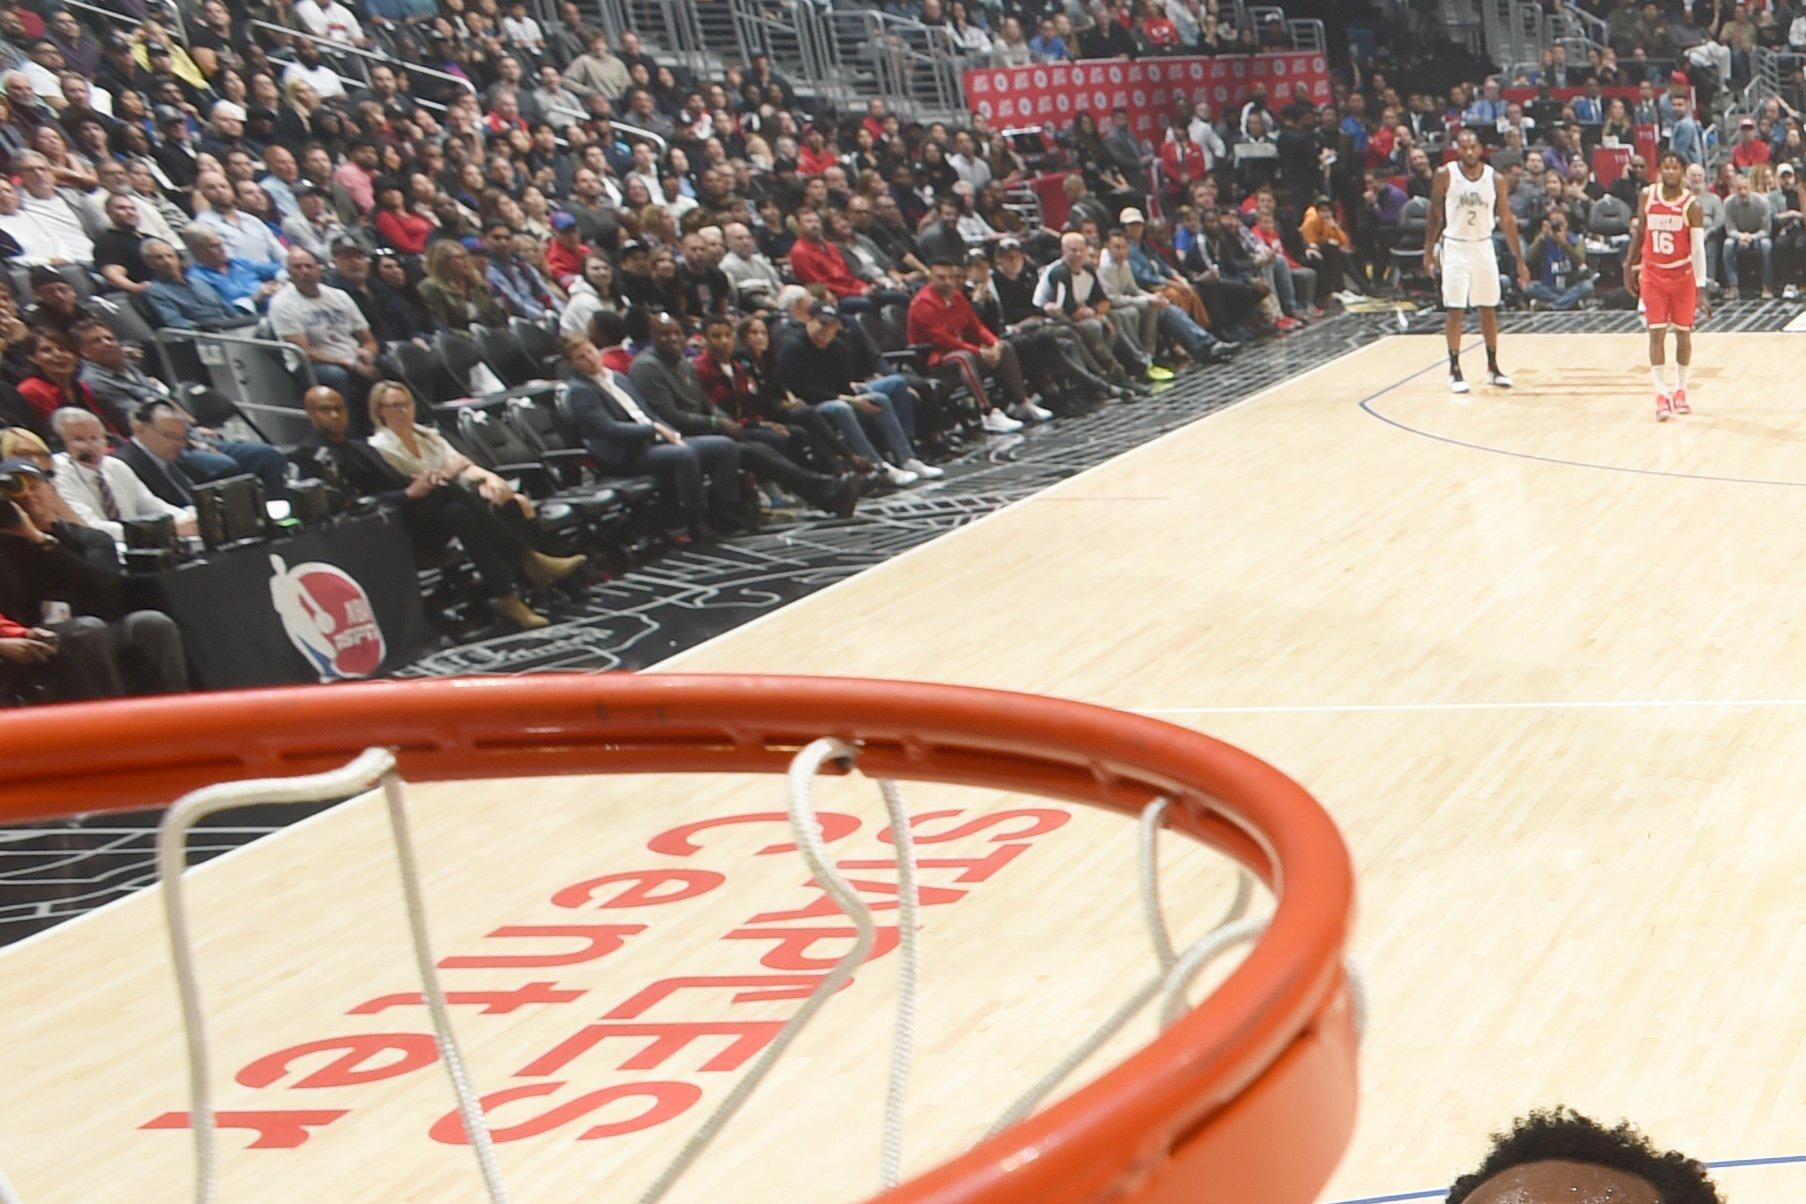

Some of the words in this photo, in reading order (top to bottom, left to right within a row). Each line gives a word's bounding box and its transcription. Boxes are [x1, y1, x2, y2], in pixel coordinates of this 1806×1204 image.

[1467, 210, 1477, 226] 2
[1651, 230, 1676, 256] 16
[137, 810, 862, 1150] Center
[428, 807, 1073, 1146] STAPLES
